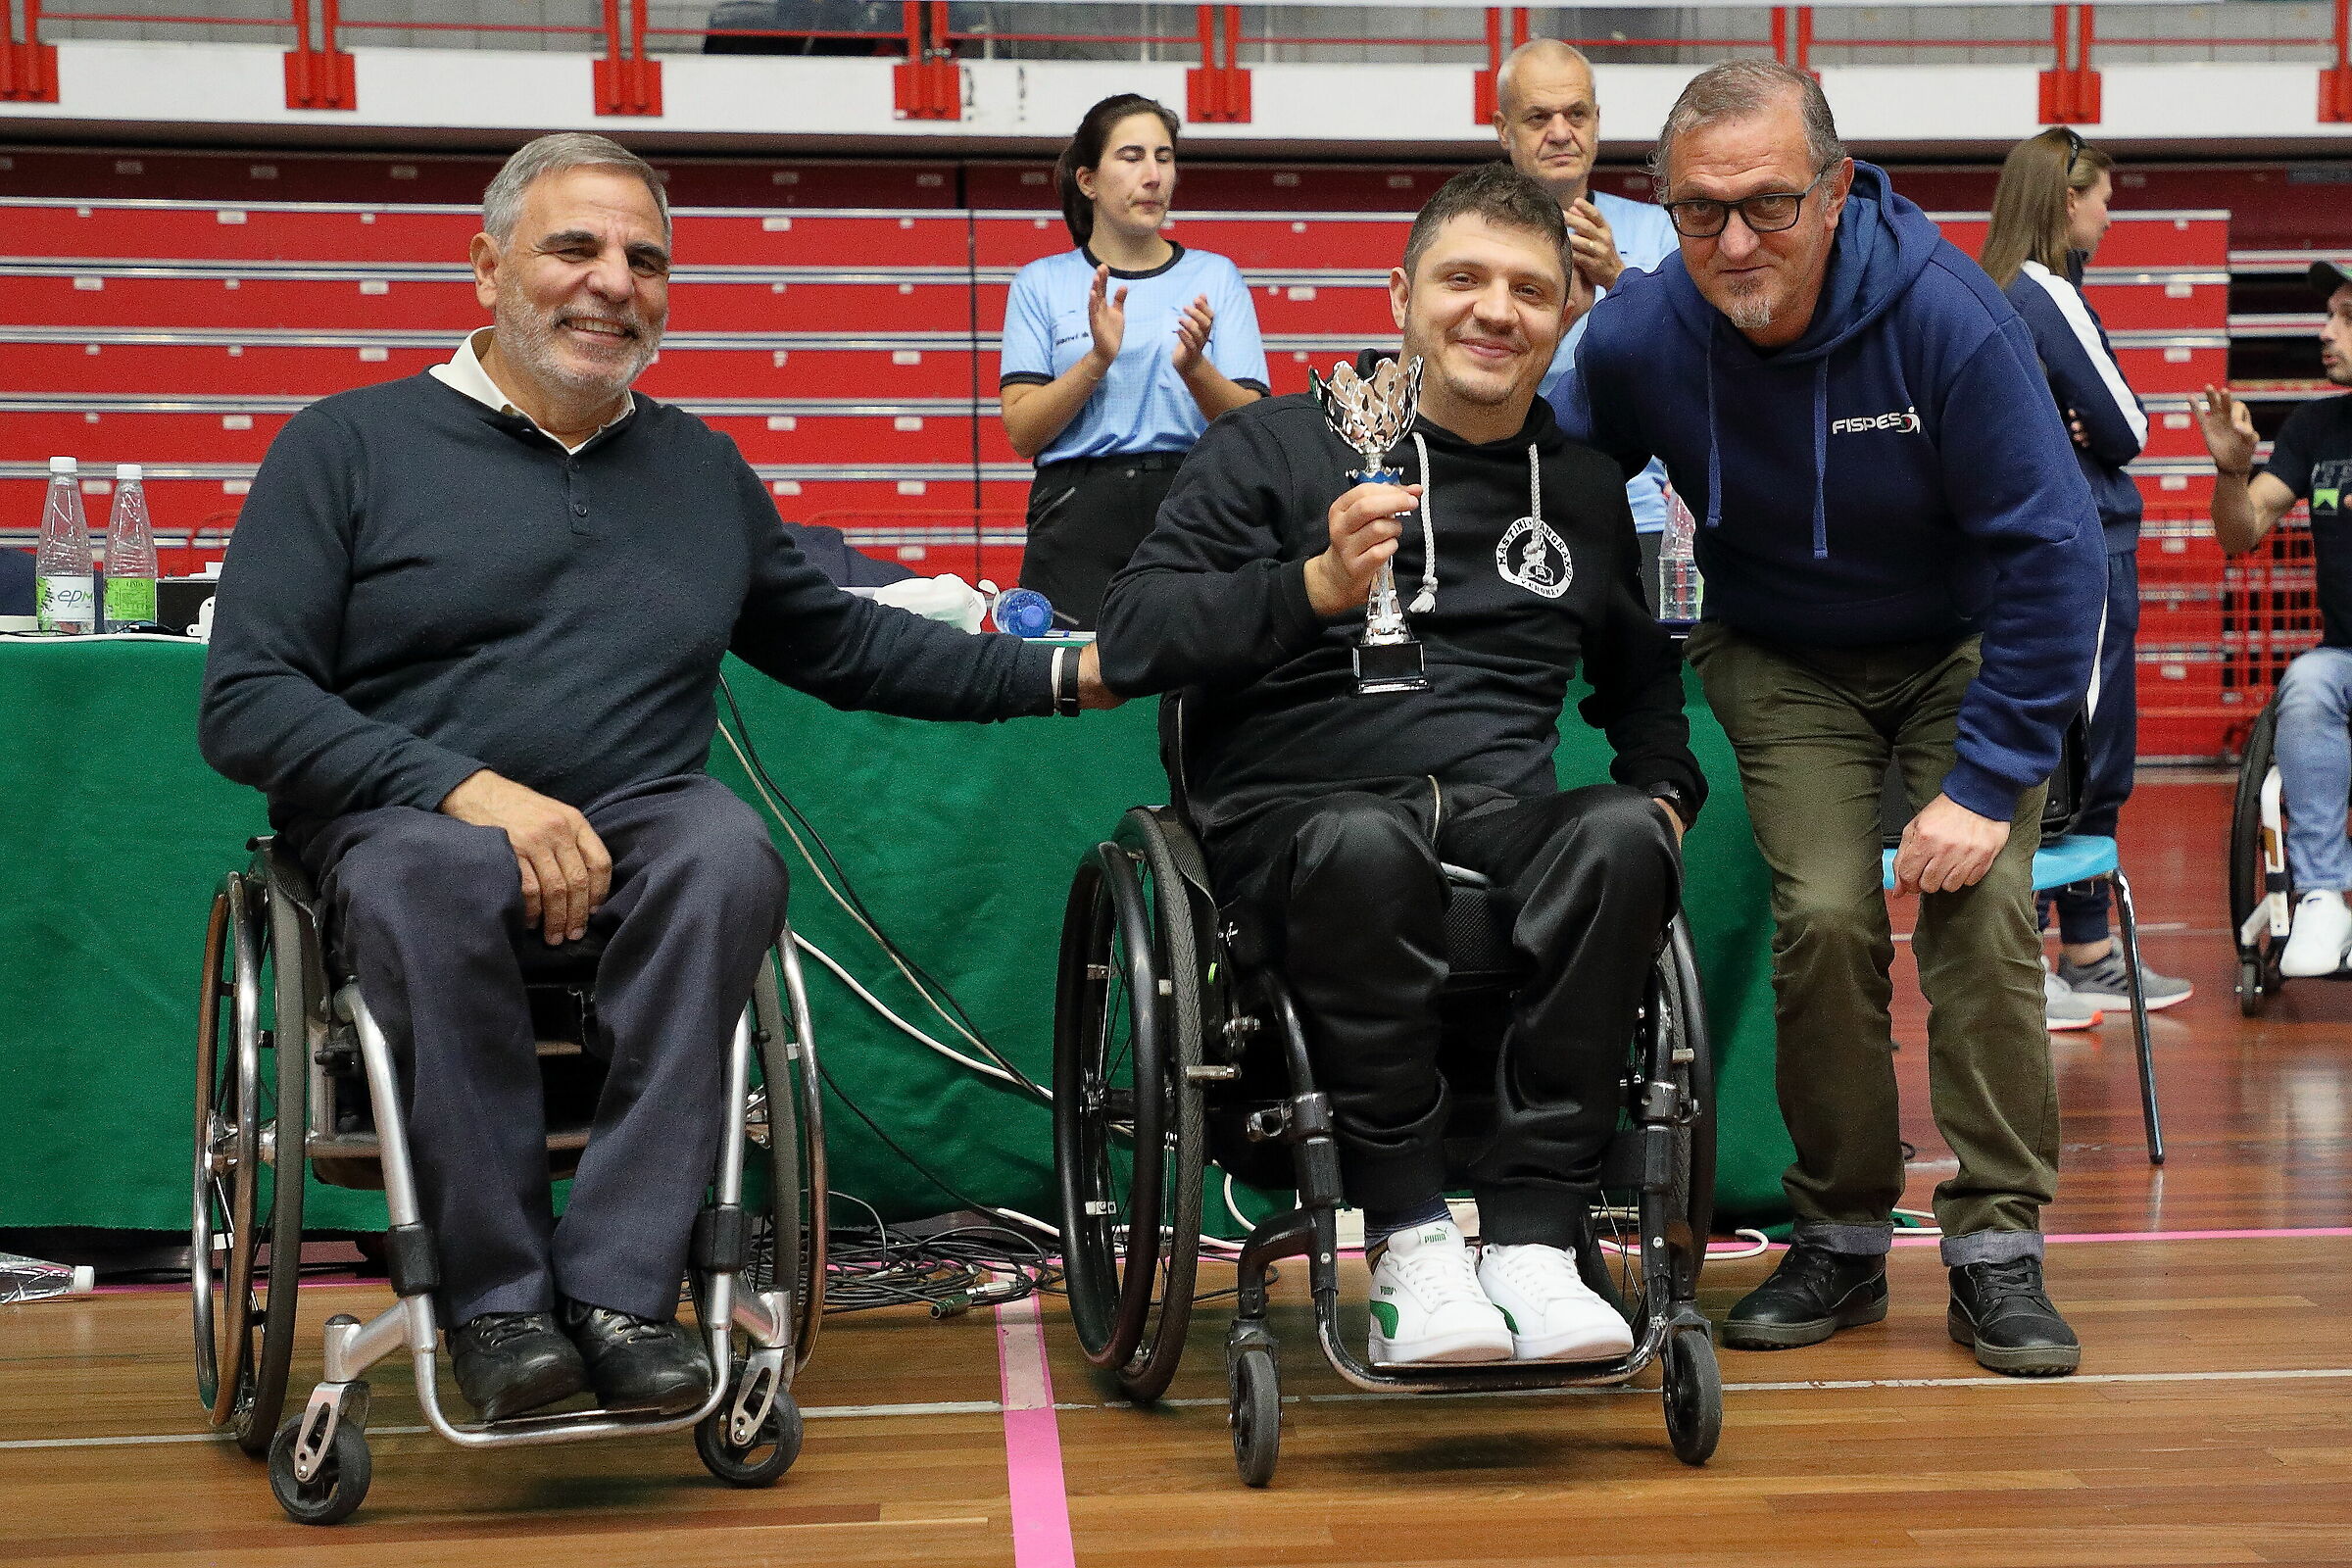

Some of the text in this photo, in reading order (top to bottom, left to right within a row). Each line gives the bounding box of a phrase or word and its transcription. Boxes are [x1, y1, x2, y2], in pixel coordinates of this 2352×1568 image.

[1832, 412, 1901, 434] FISPES
[1530, 520, 1573, 581] ANGRANDI
[1424, 1233, 1446, 1244] PUMA
